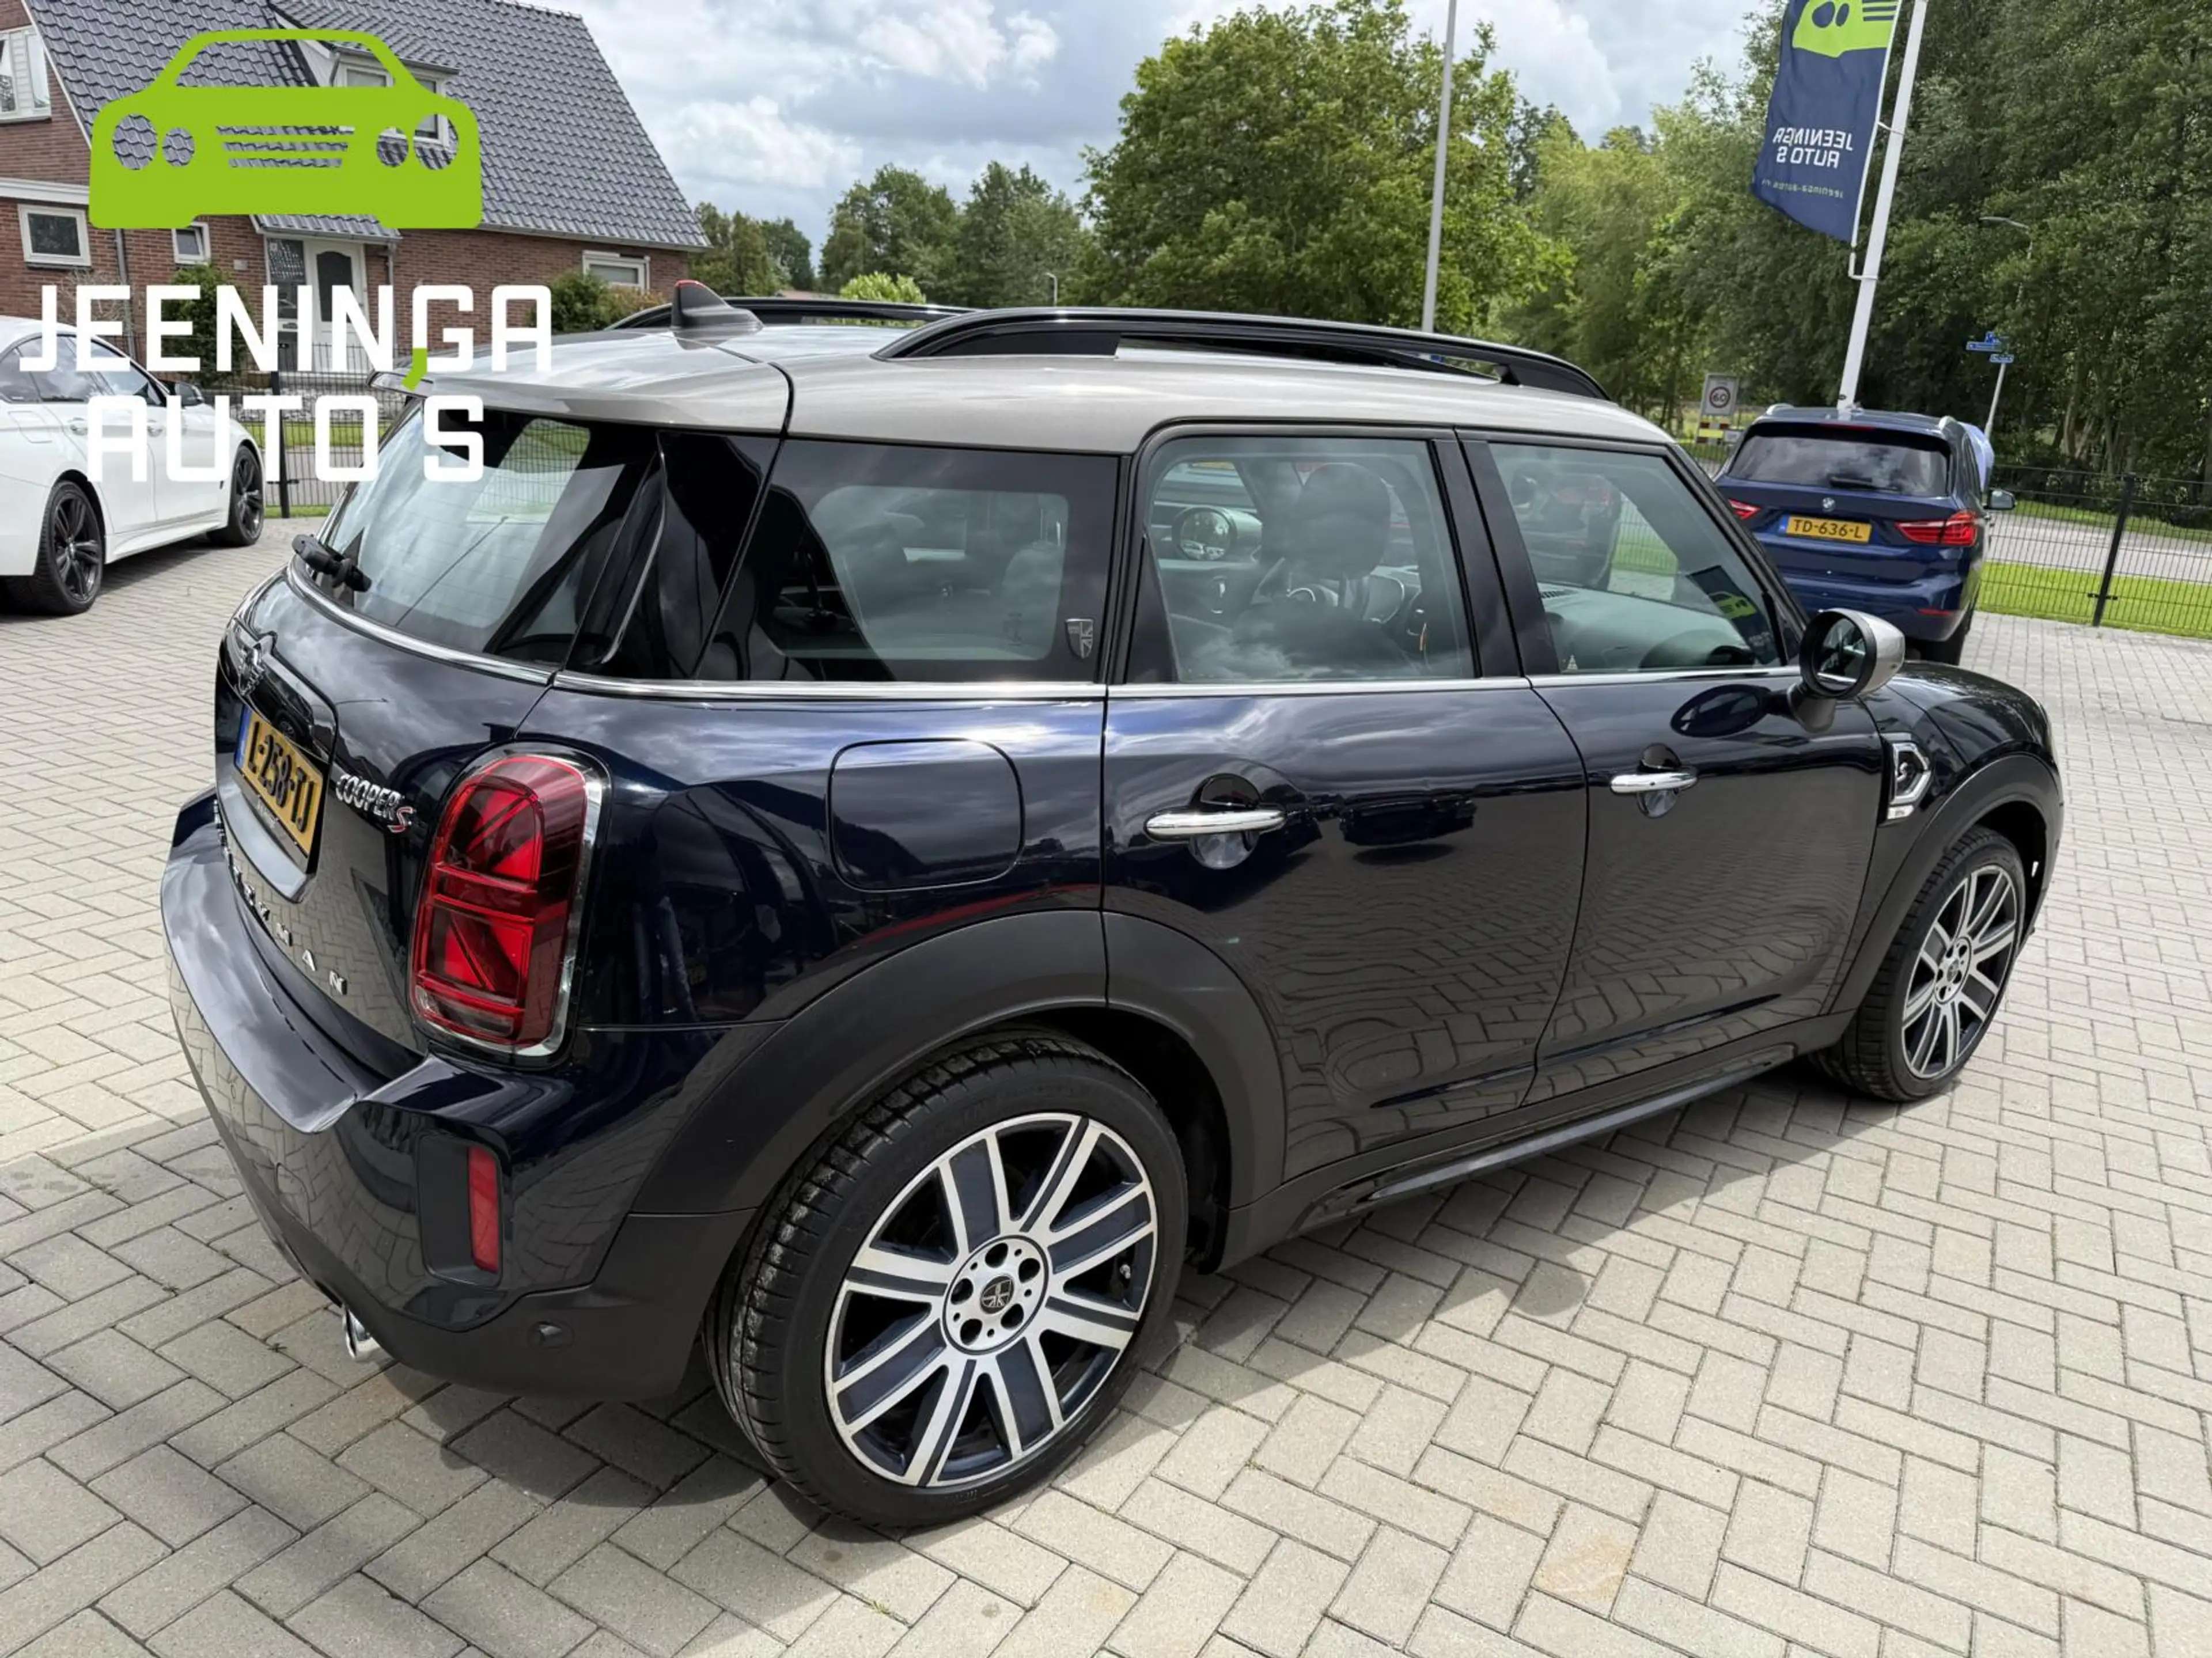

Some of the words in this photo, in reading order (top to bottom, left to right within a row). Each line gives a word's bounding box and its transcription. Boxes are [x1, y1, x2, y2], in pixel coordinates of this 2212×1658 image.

[1713, 393, 1727, 402] 60
[1793, 519, 1863, 539] TD-636-L
[248, 721, 315, 833] L-258-TJ
[336, 773, 402, 821] COOPER
